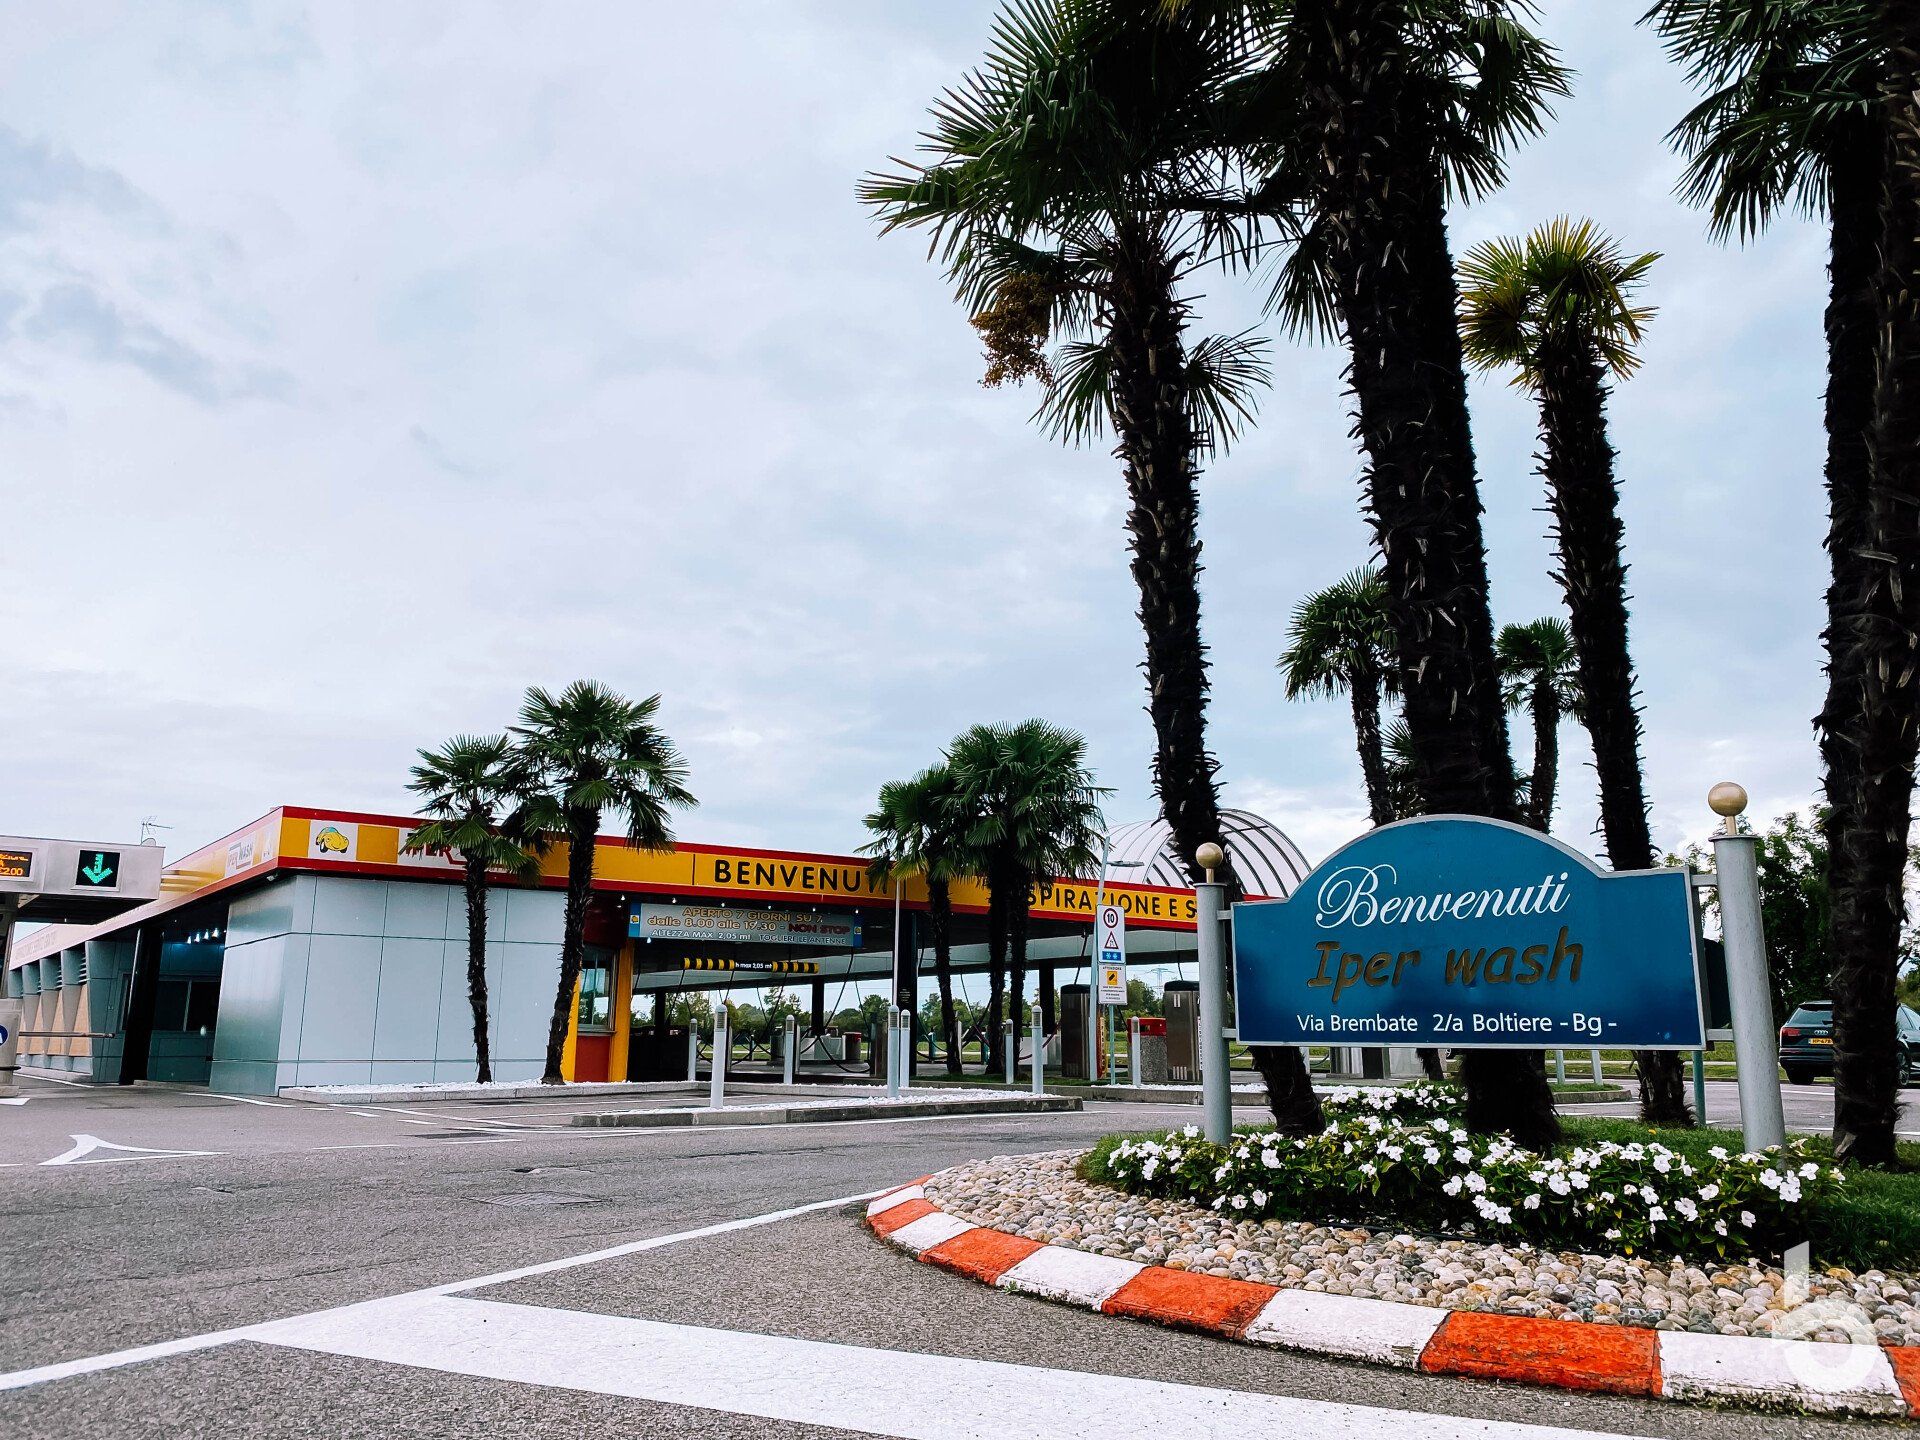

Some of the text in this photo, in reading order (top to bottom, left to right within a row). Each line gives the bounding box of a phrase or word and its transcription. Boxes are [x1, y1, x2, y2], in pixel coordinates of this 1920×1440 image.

[1315, 863, 1571, 929] Benvenuti
[682, 906, 733, 919] APERTO
[736, 910, 744, 919] 7
[747, 911, 791, 921] GIORNI
[796, 913, 813, 922] SU
[1168, 898, 1178, 917] E
[1185, 899, 1198, 919] S
[647, 915, 681, 927] dalle
[684, 917, 714, 928] 8.00
[717, 919, 740, 929] alle
[743, 920, 776, 931] 19.30
[788, 923, 817, 933] NON
[820, 924, 850, 935] STOP
[1106, 913, 1115, 923] 10
[651, 929, 690, 938] ALTEZZA
[692, 930, 714, 938] MAX
[718, 932, 737, 940] 2,05
[808, 936, 845, 944] ANTENNE
[752, 962, 764, 970] 2,05
[1306, 925, 1584, 1005] Iper wash
[1296, 1014, 1325, 1032] Via
[1330, 1013, 1419, 1032] Brembate
[1432, 1013, 1464, 1032] 2/a
[1472, 1012, 1553, 1032] Boltiere
